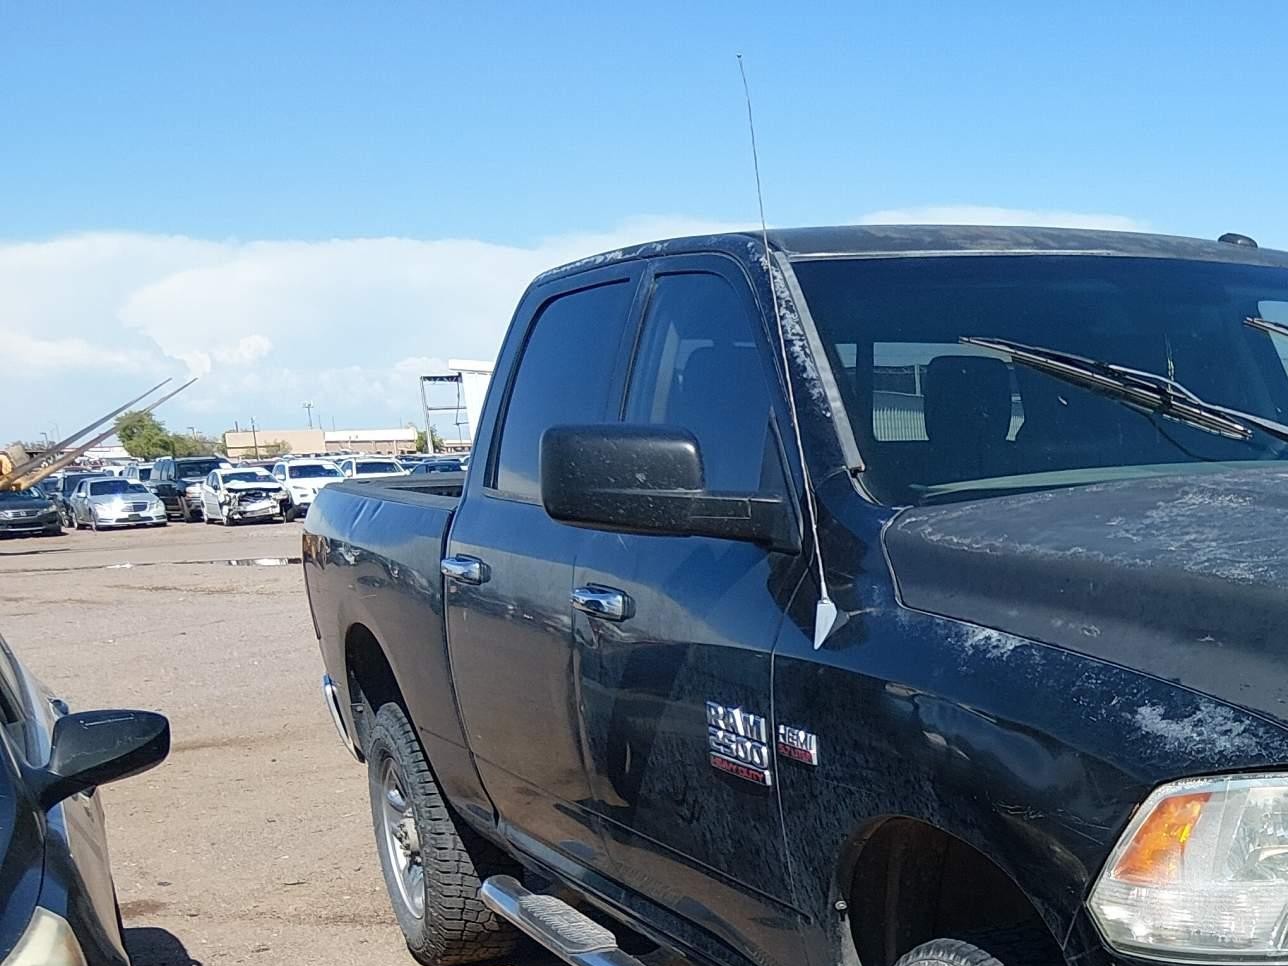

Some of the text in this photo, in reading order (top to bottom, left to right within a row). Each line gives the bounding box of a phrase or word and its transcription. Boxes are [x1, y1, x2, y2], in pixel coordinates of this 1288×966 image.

[705, 701, 766, 743] RAM
[779, 725, 817, 751] HEMI
[709, 726, 767, 769] 2500
